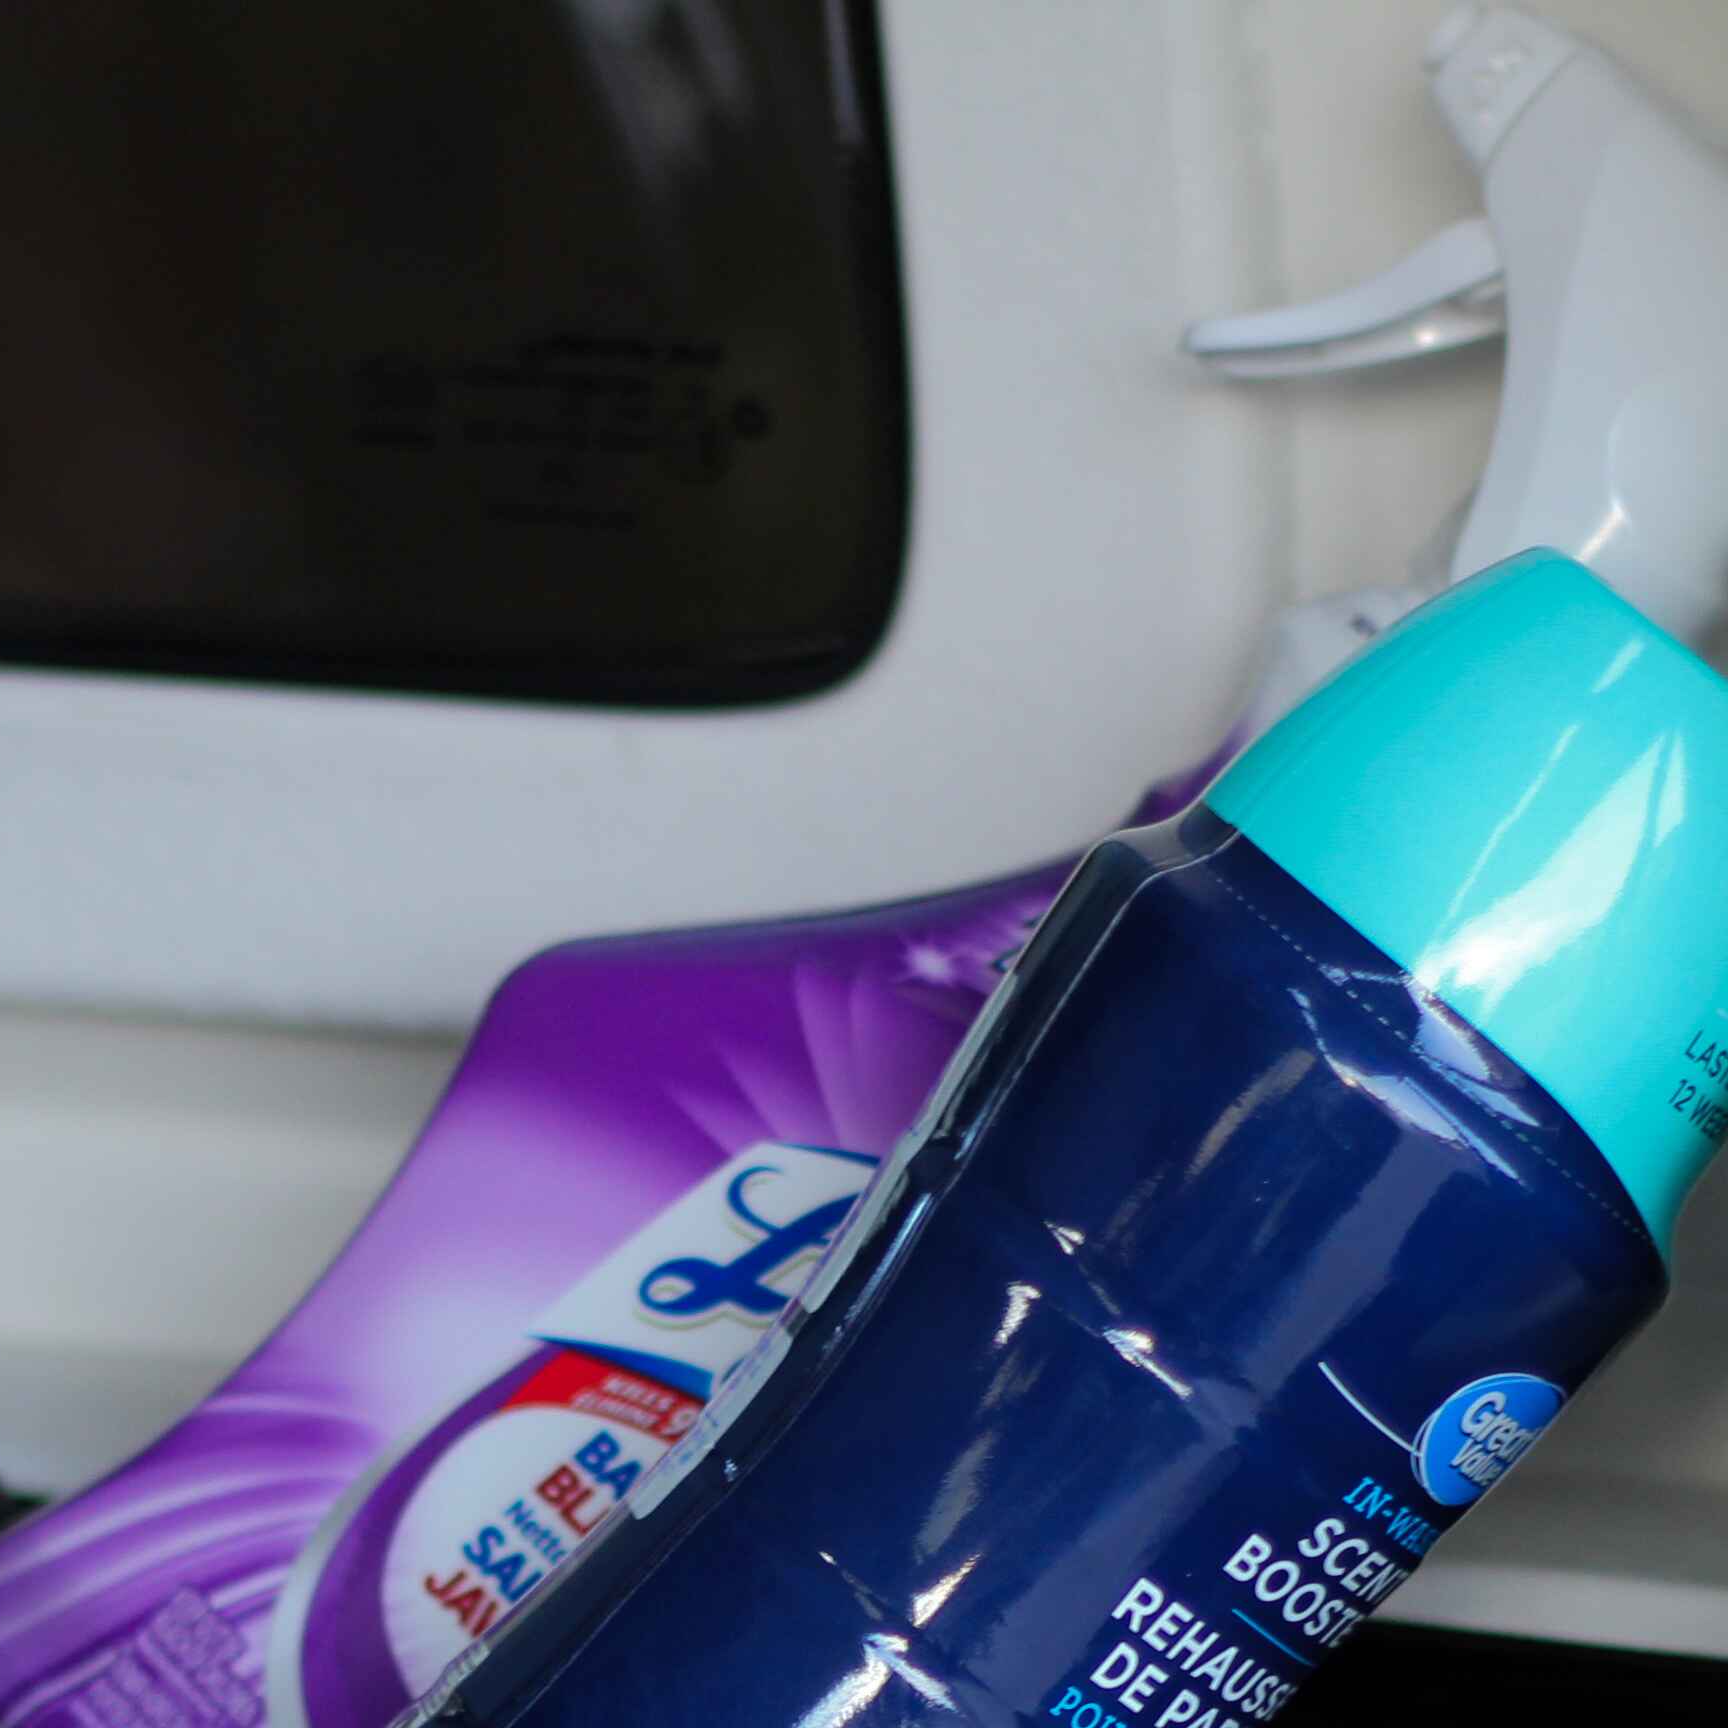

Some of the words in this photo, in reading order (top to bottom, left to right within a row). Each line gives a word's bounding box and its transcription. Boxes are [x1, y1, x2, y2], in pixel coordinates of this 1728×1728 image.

[1668, 1079, 1696, 1112] 12
[535, 1465, 610, 1536] BL
[1089, 1641, 1170, 1713] DE
